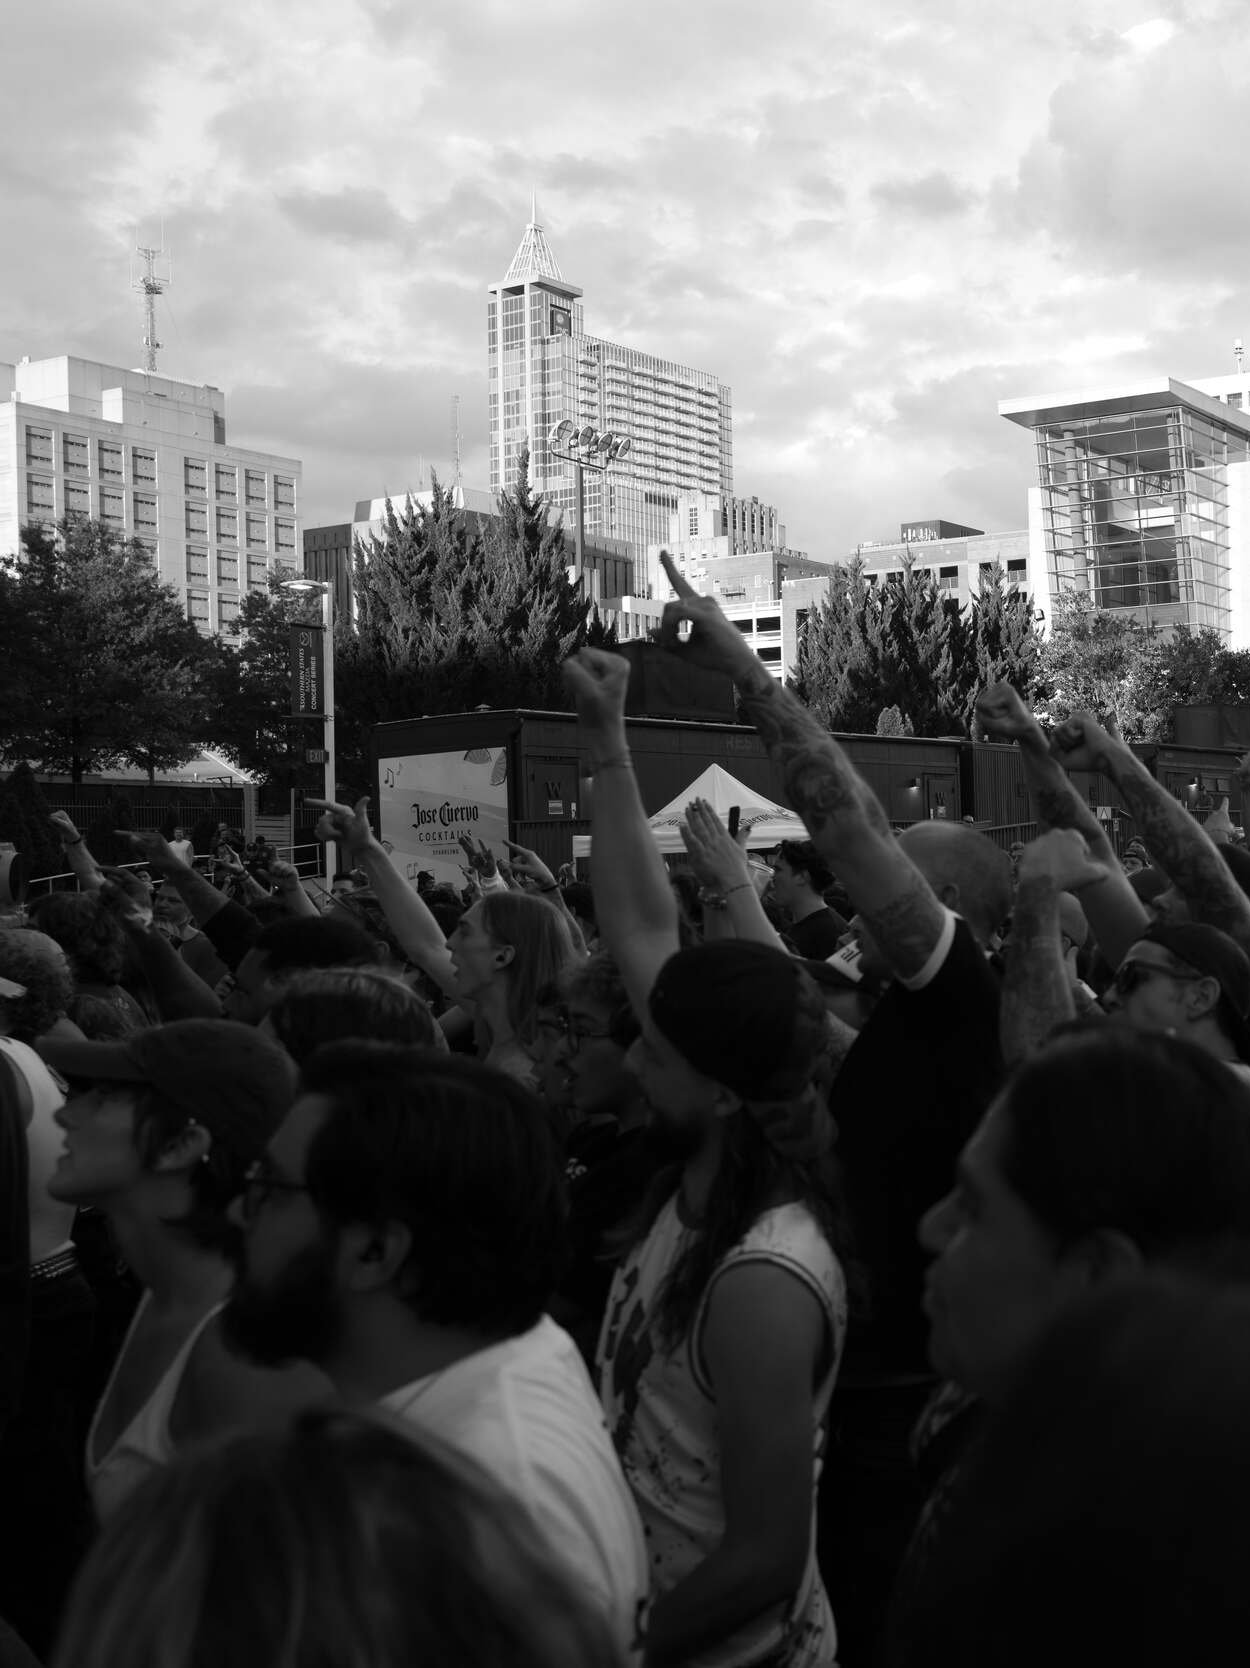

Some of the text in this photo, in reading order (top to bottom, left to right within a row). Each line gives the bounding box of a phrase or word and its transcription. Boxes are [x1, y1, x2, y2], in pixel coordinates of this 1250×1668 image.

[310, 750, 325, 762] EXIT
[410, 801, 479, 829] Jose Cuervo
